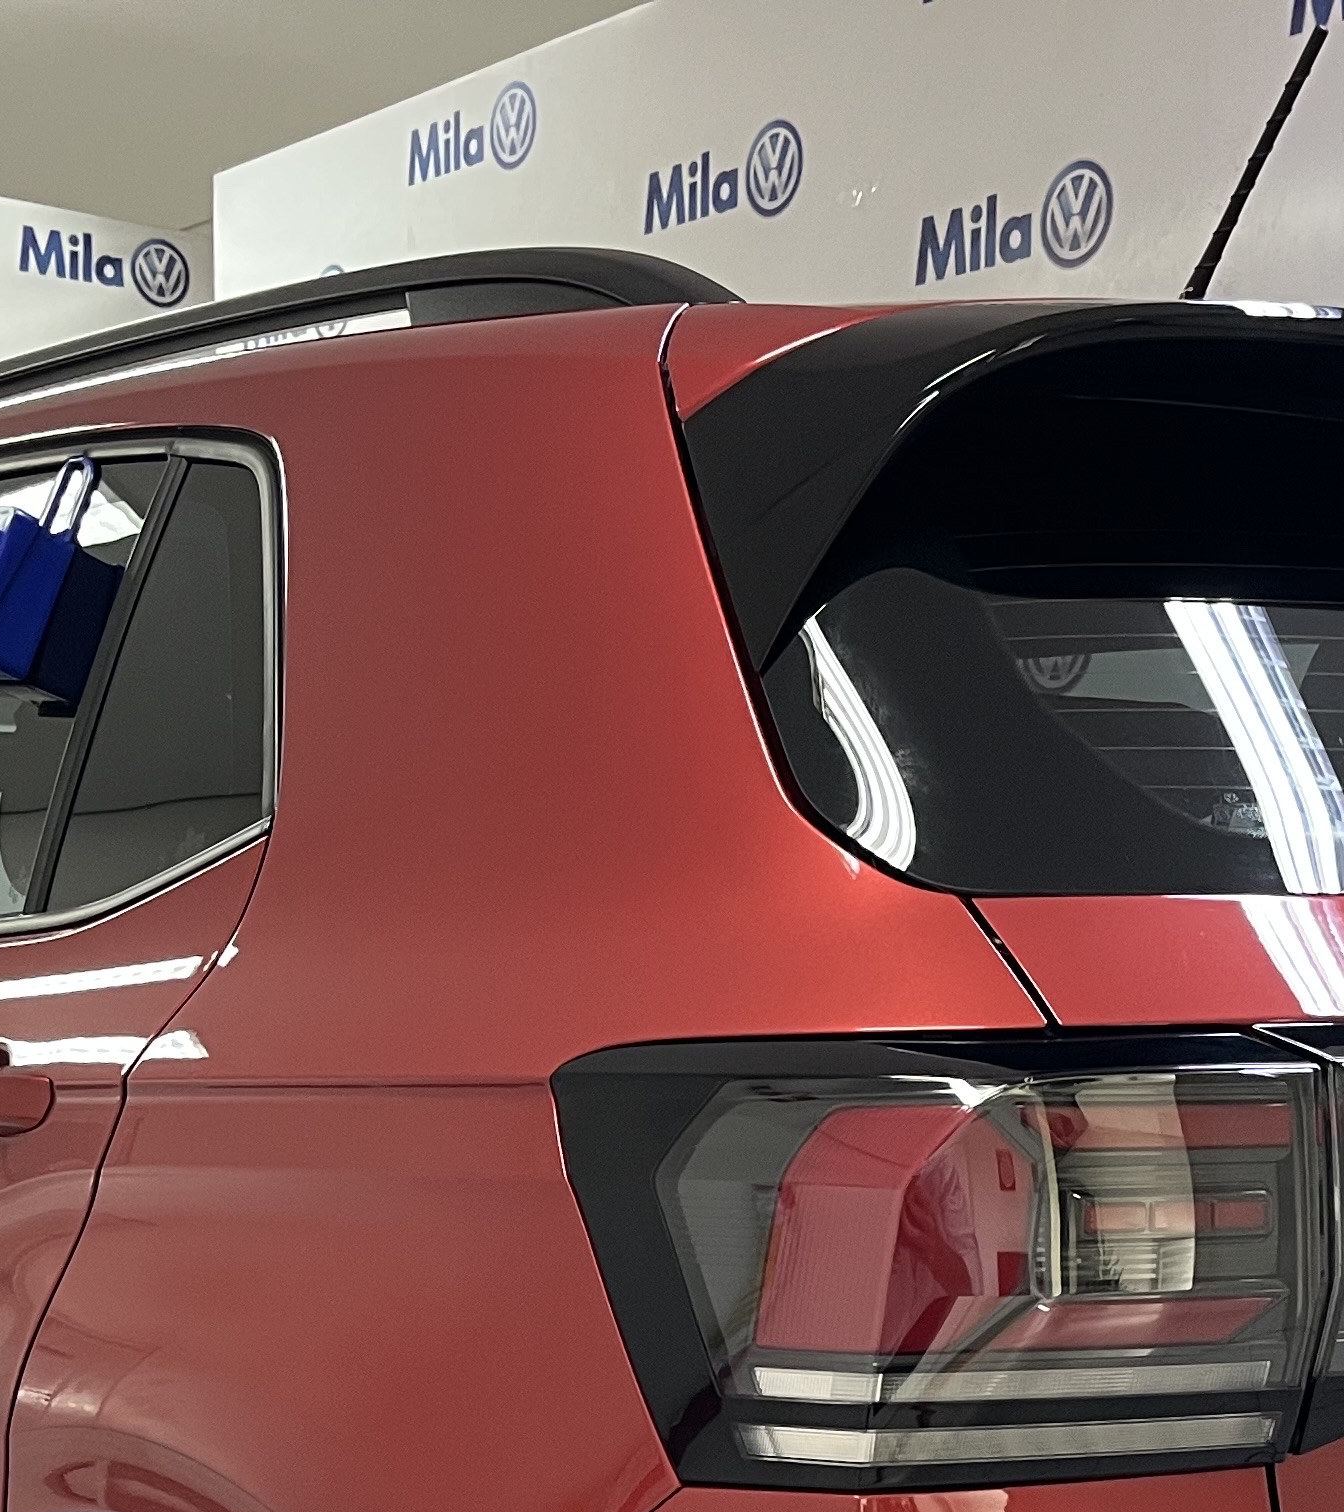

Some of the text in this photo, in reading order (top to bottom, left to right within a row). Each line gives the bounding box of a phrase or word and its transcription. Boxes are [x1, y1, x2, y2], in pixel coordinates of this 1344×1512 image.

[408, 111, 485, 186] Mila
[644, 151, 738, 235] Mila
[19, 226, 124, 288] Mila
[915, 195, 1032, 286] Mila
